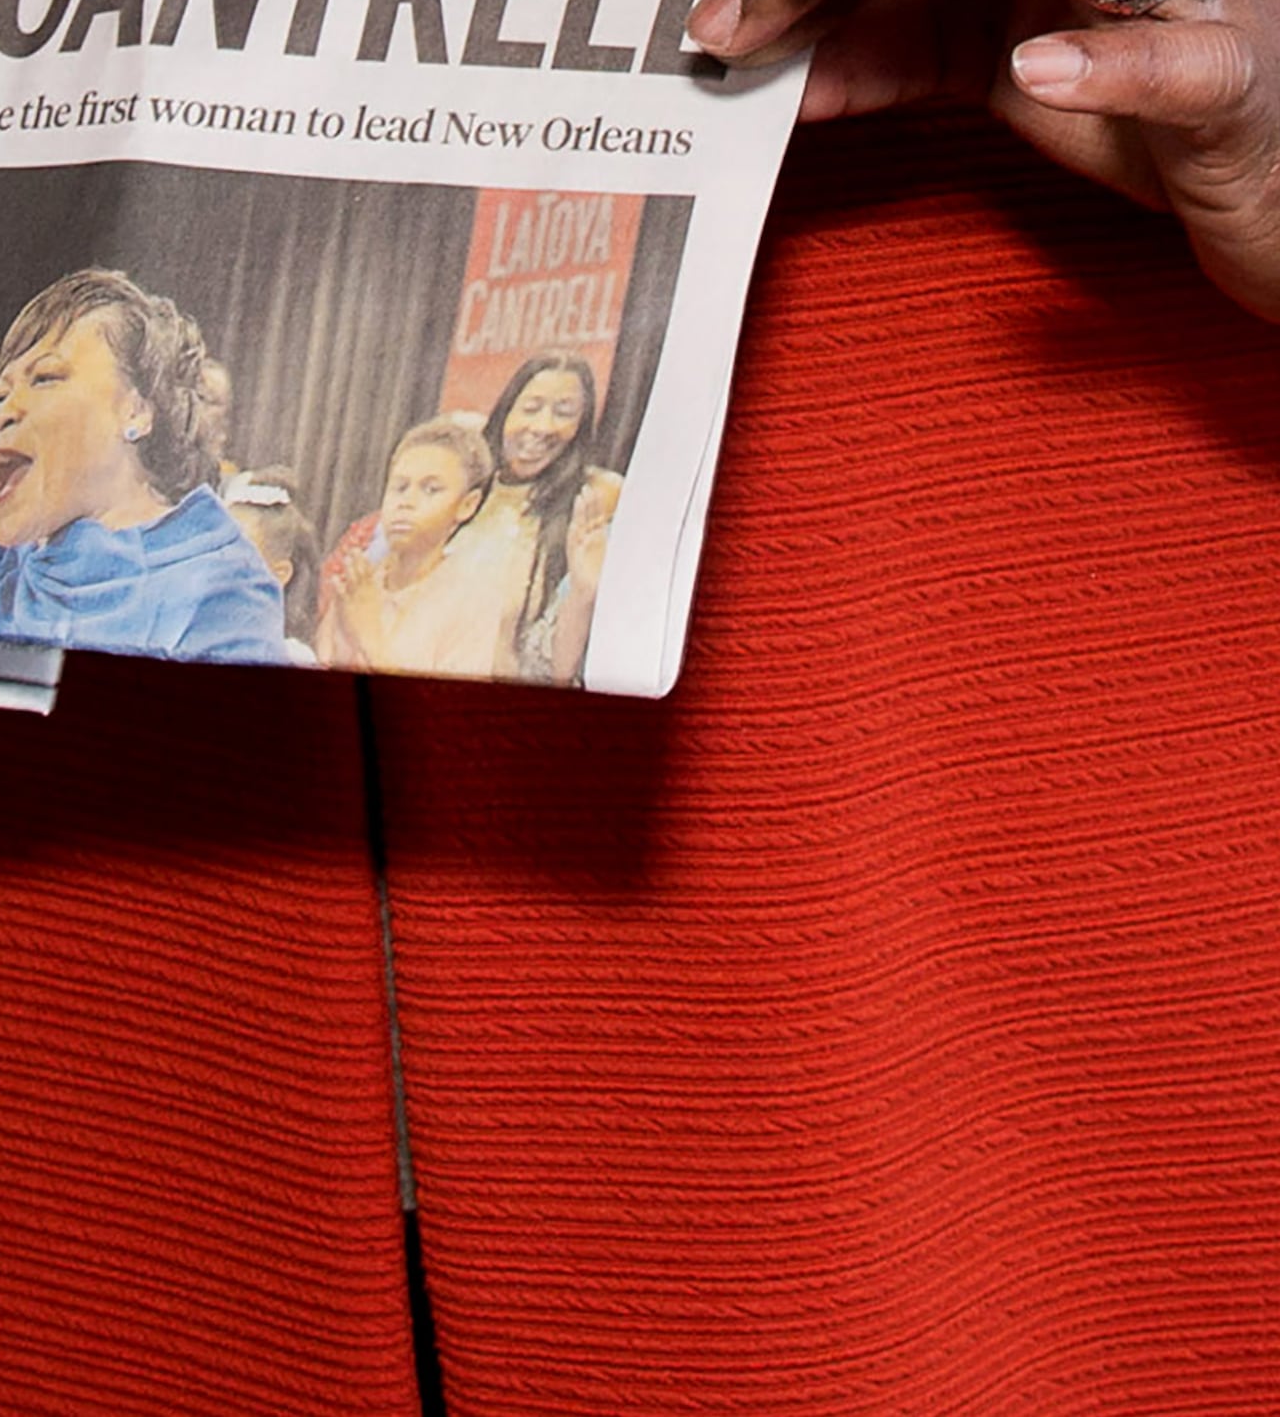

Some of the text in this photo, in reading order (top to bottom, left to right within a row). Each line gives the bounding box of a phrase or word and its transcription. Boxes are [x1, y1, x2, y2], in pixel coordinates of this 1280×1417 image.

[20, 95, 71, 130] the
[75, 90, 140, 127] first
[150, 96, 297, 136] woman
[306, 106, 345, 138] to
[353, 104, 437, 144] lead
[440, 111, 534, 149] New
[541, 116, 694, 156] Orleans
[453, 269, 617, 356] CANTRELL
